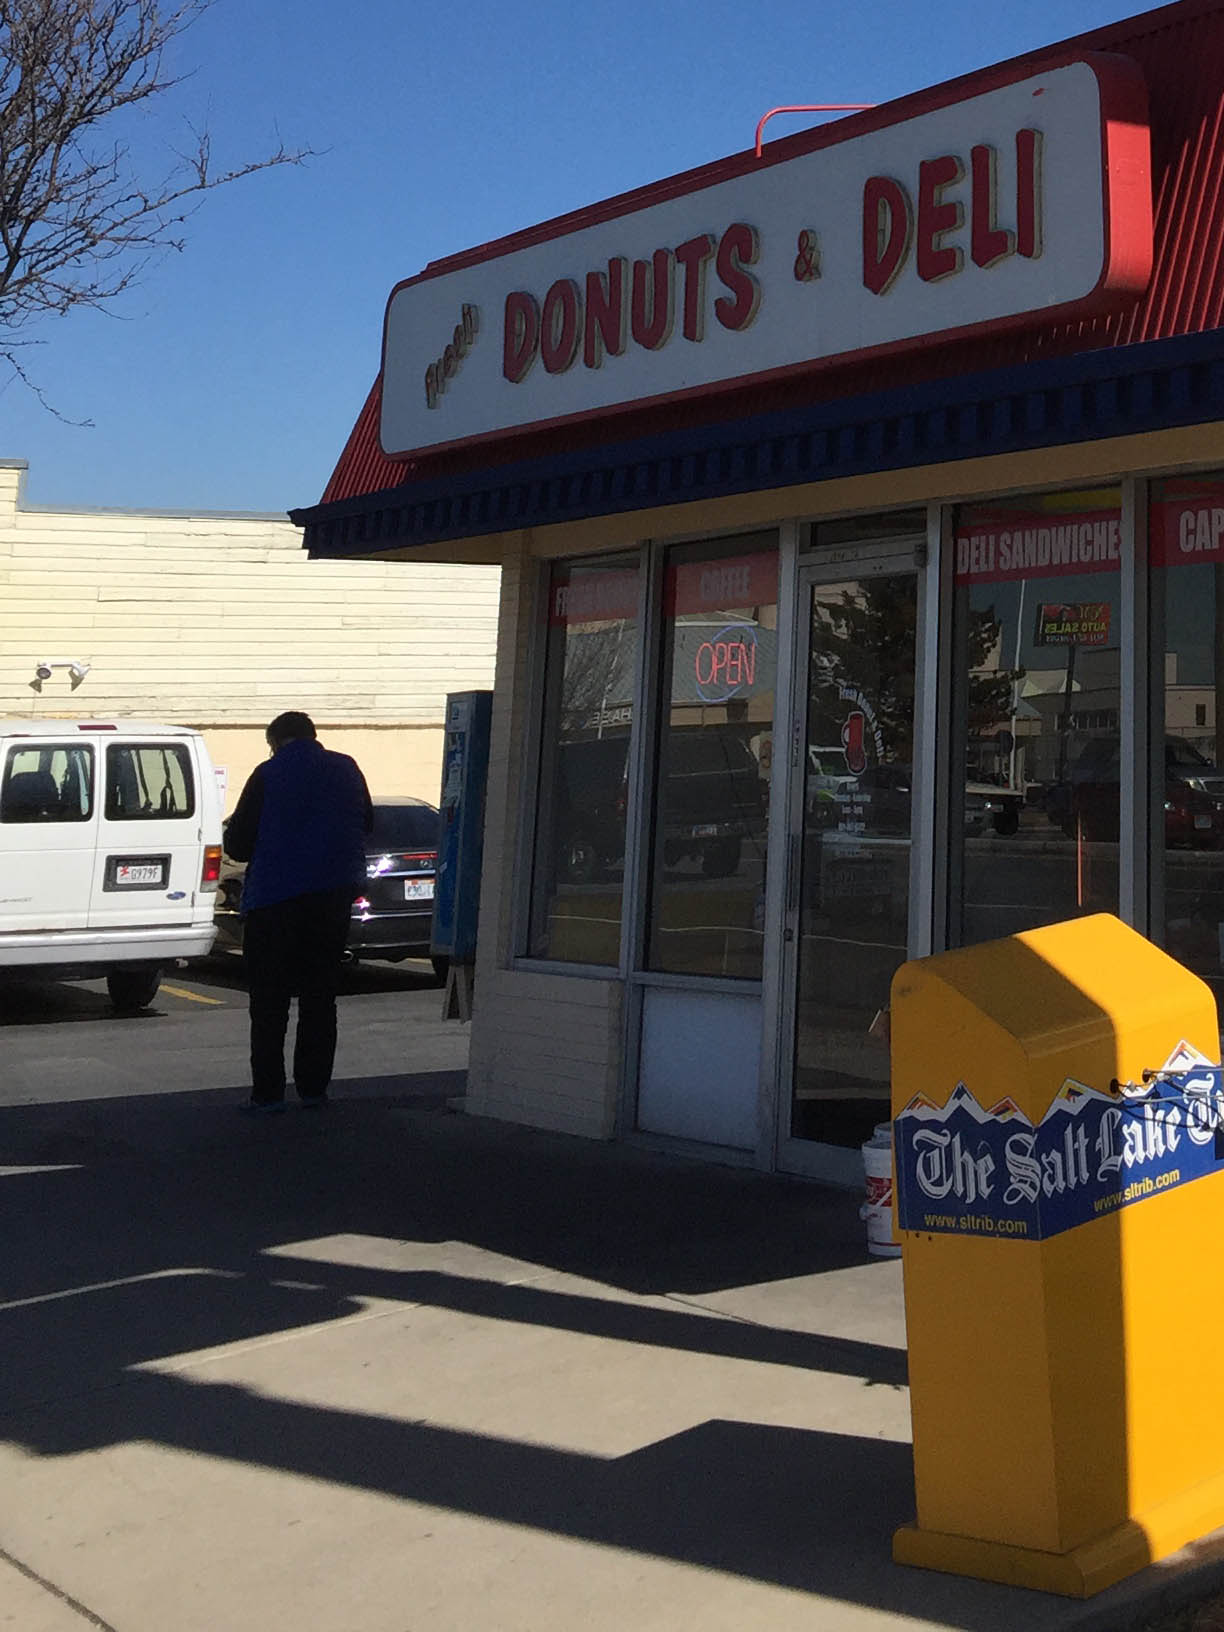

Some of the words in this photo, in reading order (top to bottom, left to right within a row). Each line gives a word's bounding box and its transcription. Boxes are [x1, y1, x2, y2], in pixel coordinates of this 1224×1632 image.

[503, 222, 761, 384] DONUTS
[793, 228, 822, 282] &
[862, 128, 1044, 296] DELI
[957, 534, 996, 575] DELI
[1000, 520, 1122, 571] SANDWICHE
[696, 642, 756, 685] OPEN
[913, 1128, 996, 1205] The
[1003, 1120, 1090, 1207] Salt
[1096, 1106, 1181, 1183] Lake
[1093, 1167, 1181, 1213] www.sltrib.com
[924, 1211, 1028, 1235] www.sltrib.com
